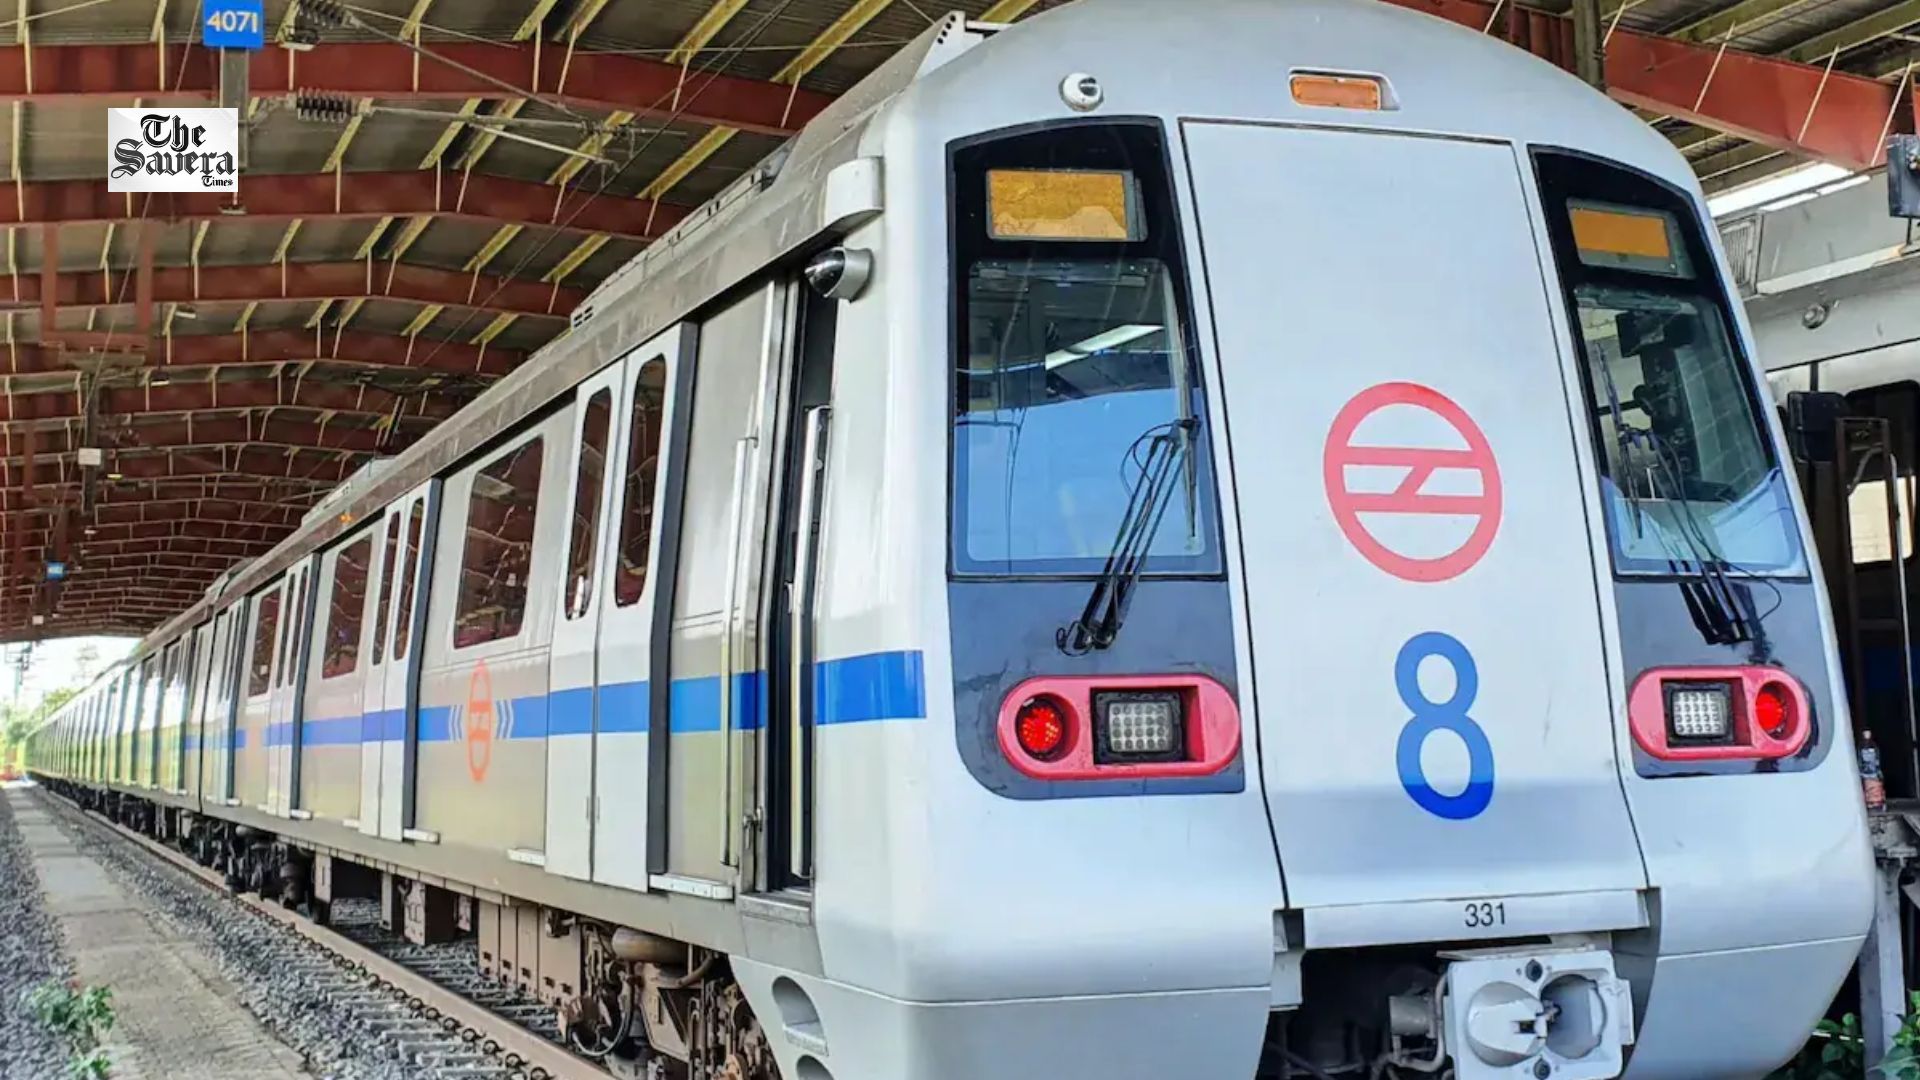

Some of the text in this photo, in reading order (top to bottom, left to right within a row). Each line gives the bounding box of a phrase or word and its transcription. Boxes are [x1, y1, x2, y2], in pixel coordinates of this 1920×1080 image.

[206, 10, 258, 33] 4071
[1395, 631, 1495, 820] 8
[1464, 901, 1506, 929] 331
